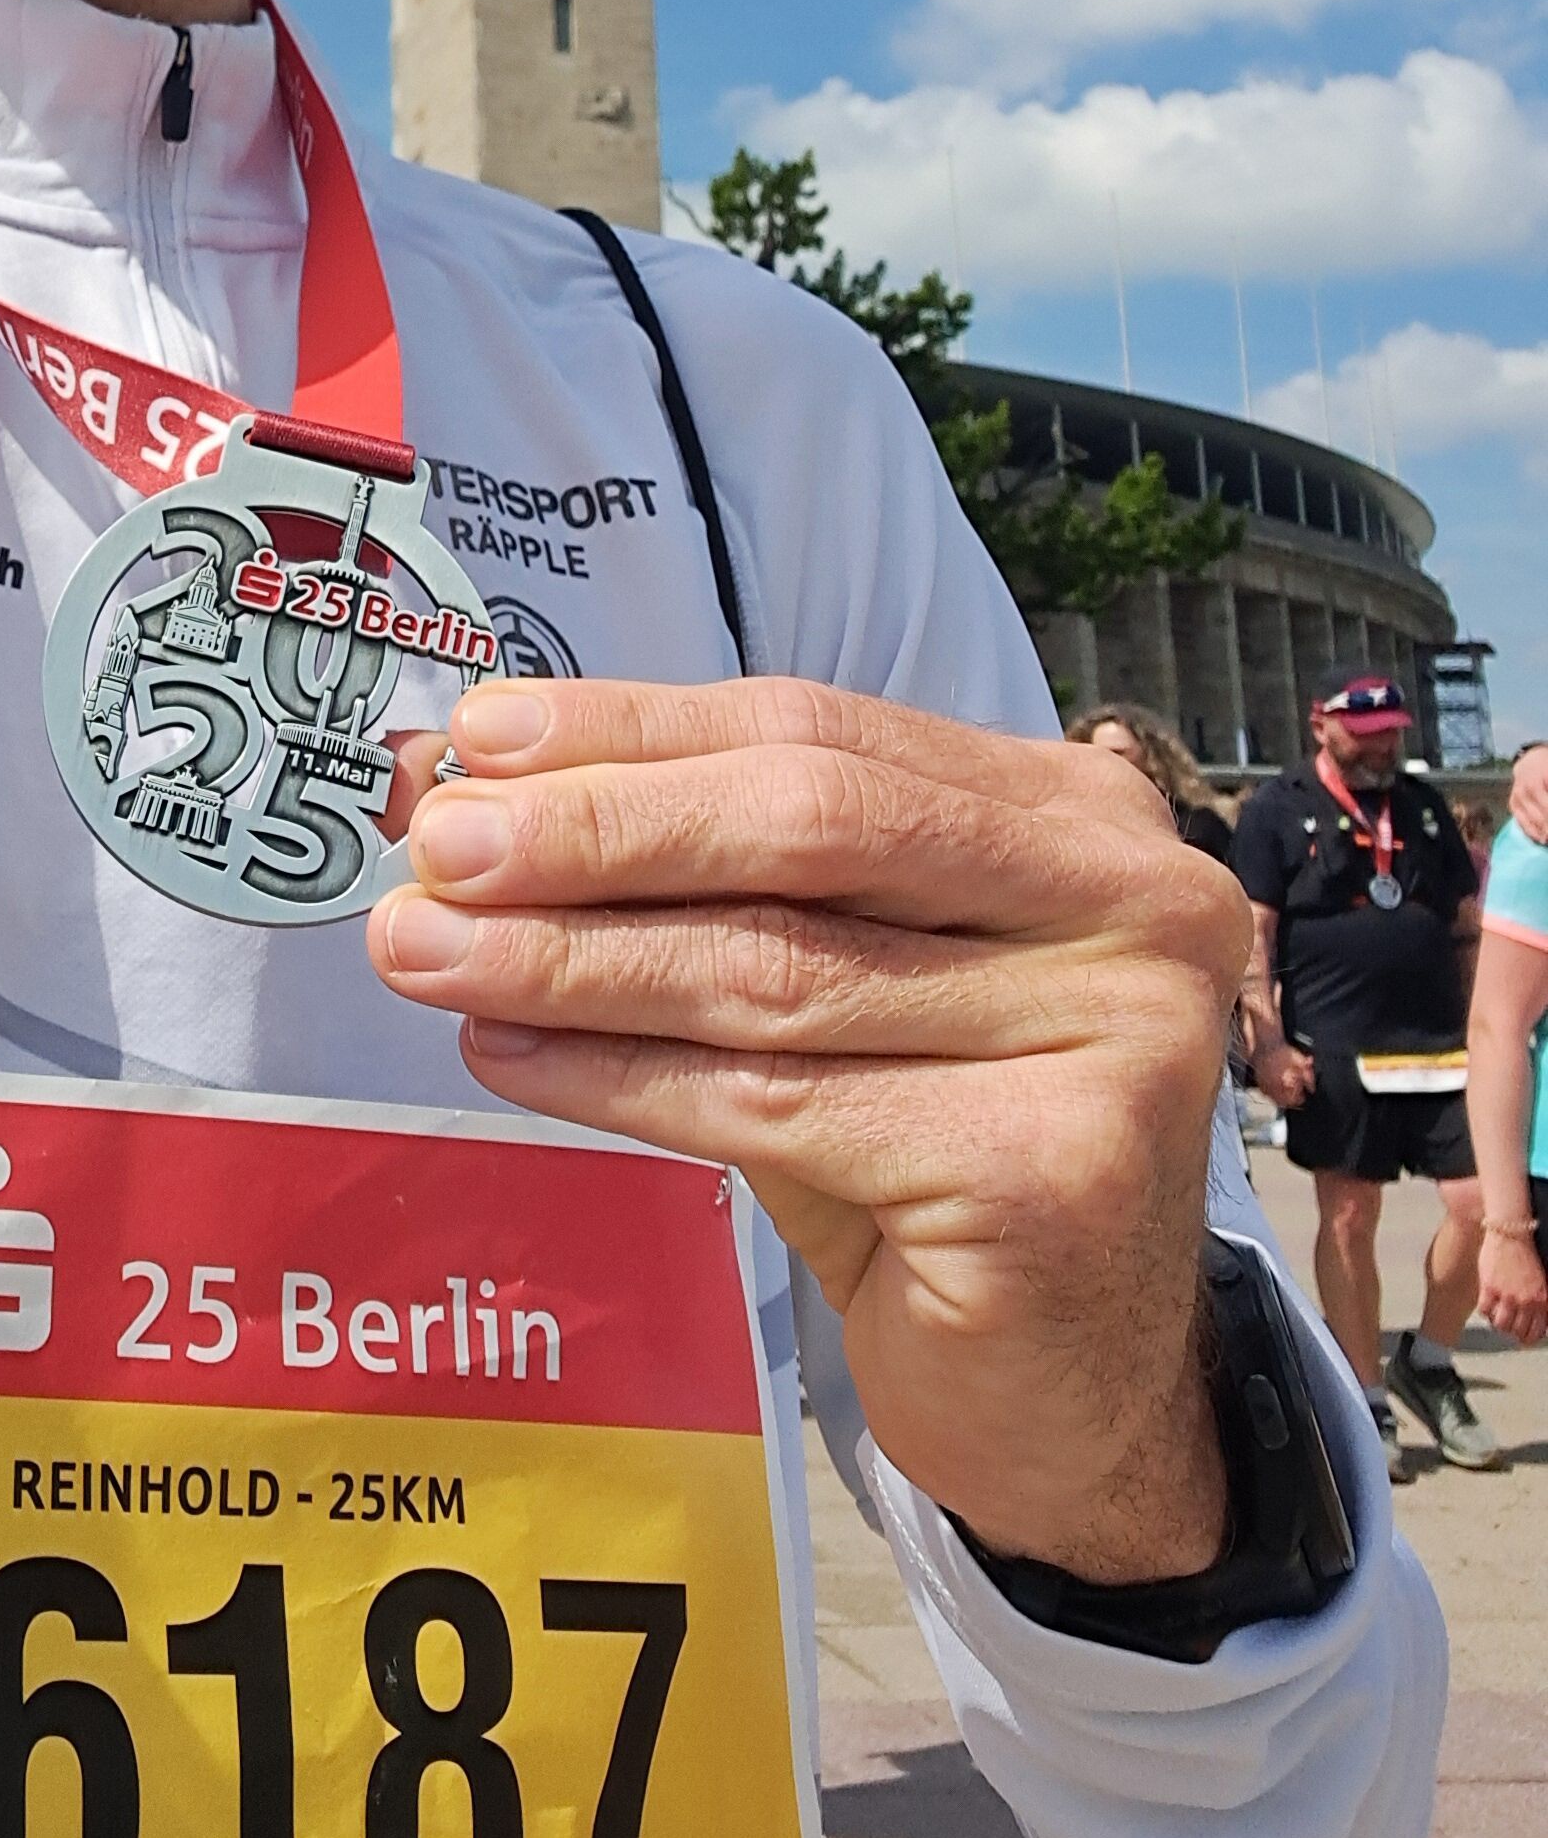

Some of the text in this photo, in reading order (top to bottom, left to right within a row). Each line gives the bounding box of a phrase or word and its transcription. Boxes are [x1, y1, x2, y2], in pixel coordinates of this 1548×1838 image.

[141, 410, 230, 482] 25
[419, 456, 658, 530] TERSPORT
[448, 515, 590, 580] RÄPPLE
[288, 576, 352, 625] 25
[358, 592, 497, 665] Berlin
[289, 748, 372, 785] 11. Mai
[117, 1260, 241, 1367] 25
[281, 1271, 564, 1383] Berlin
[12, 1458, 281, 1520] REINHOLD
[328, 1472, 468, 1526] 25KM
